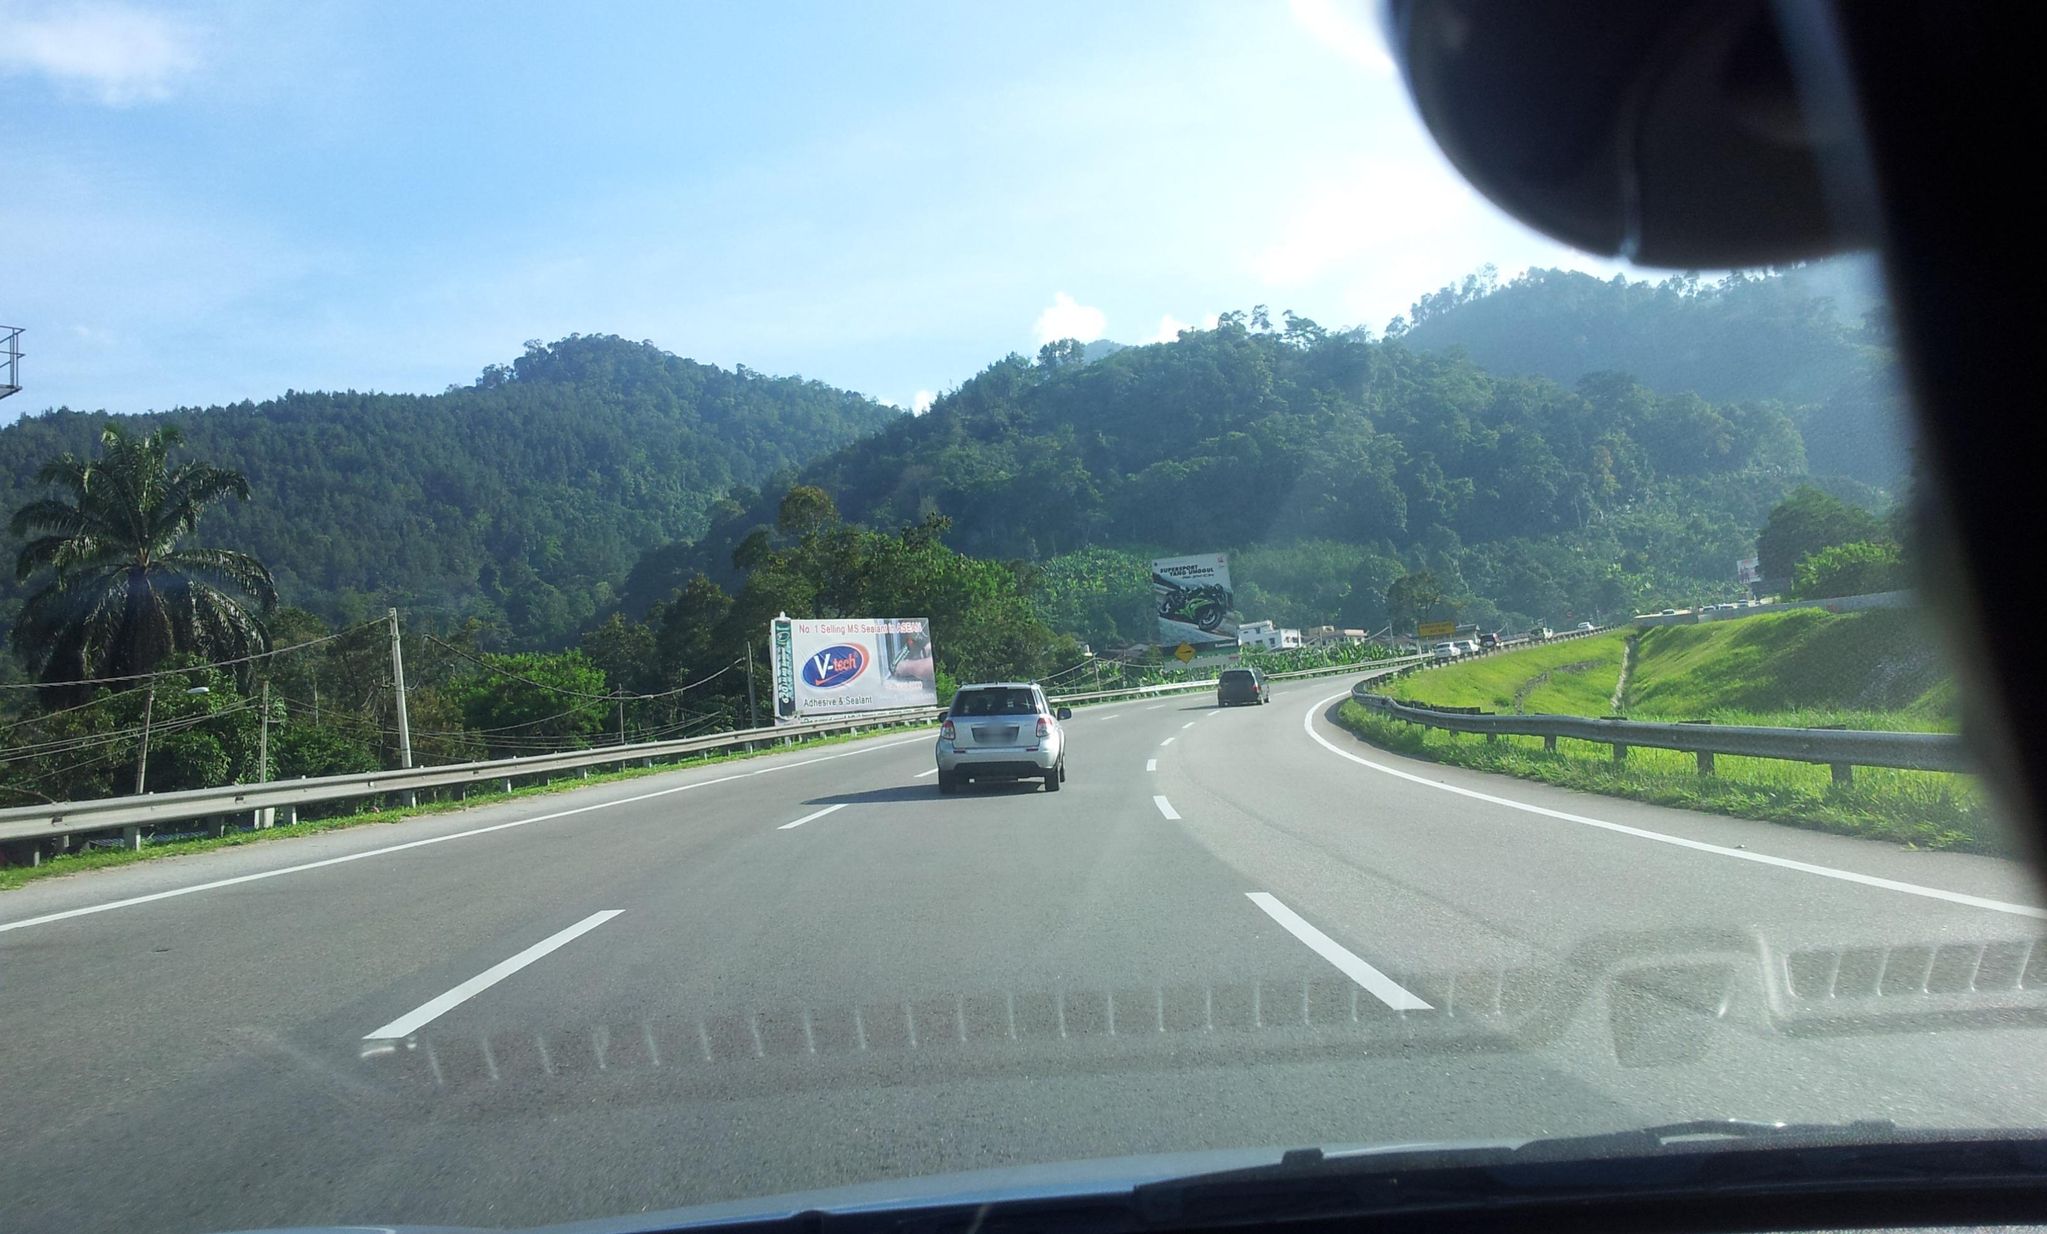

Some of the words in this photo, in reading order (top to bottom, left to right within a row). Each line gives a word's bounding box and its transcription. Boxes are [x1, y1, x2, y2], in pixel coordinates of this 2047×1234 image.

[821, 624, 846, 635] Selling
[847, 623, 859, 633] MS
[861, 623, 888, 633] Sealant
[814, 653, 856, 679] V-tech
[803, 698, 836, 707] Adhesive
[838, 697, 844, 705] &
[845, 695, 872, 705] Sealant
